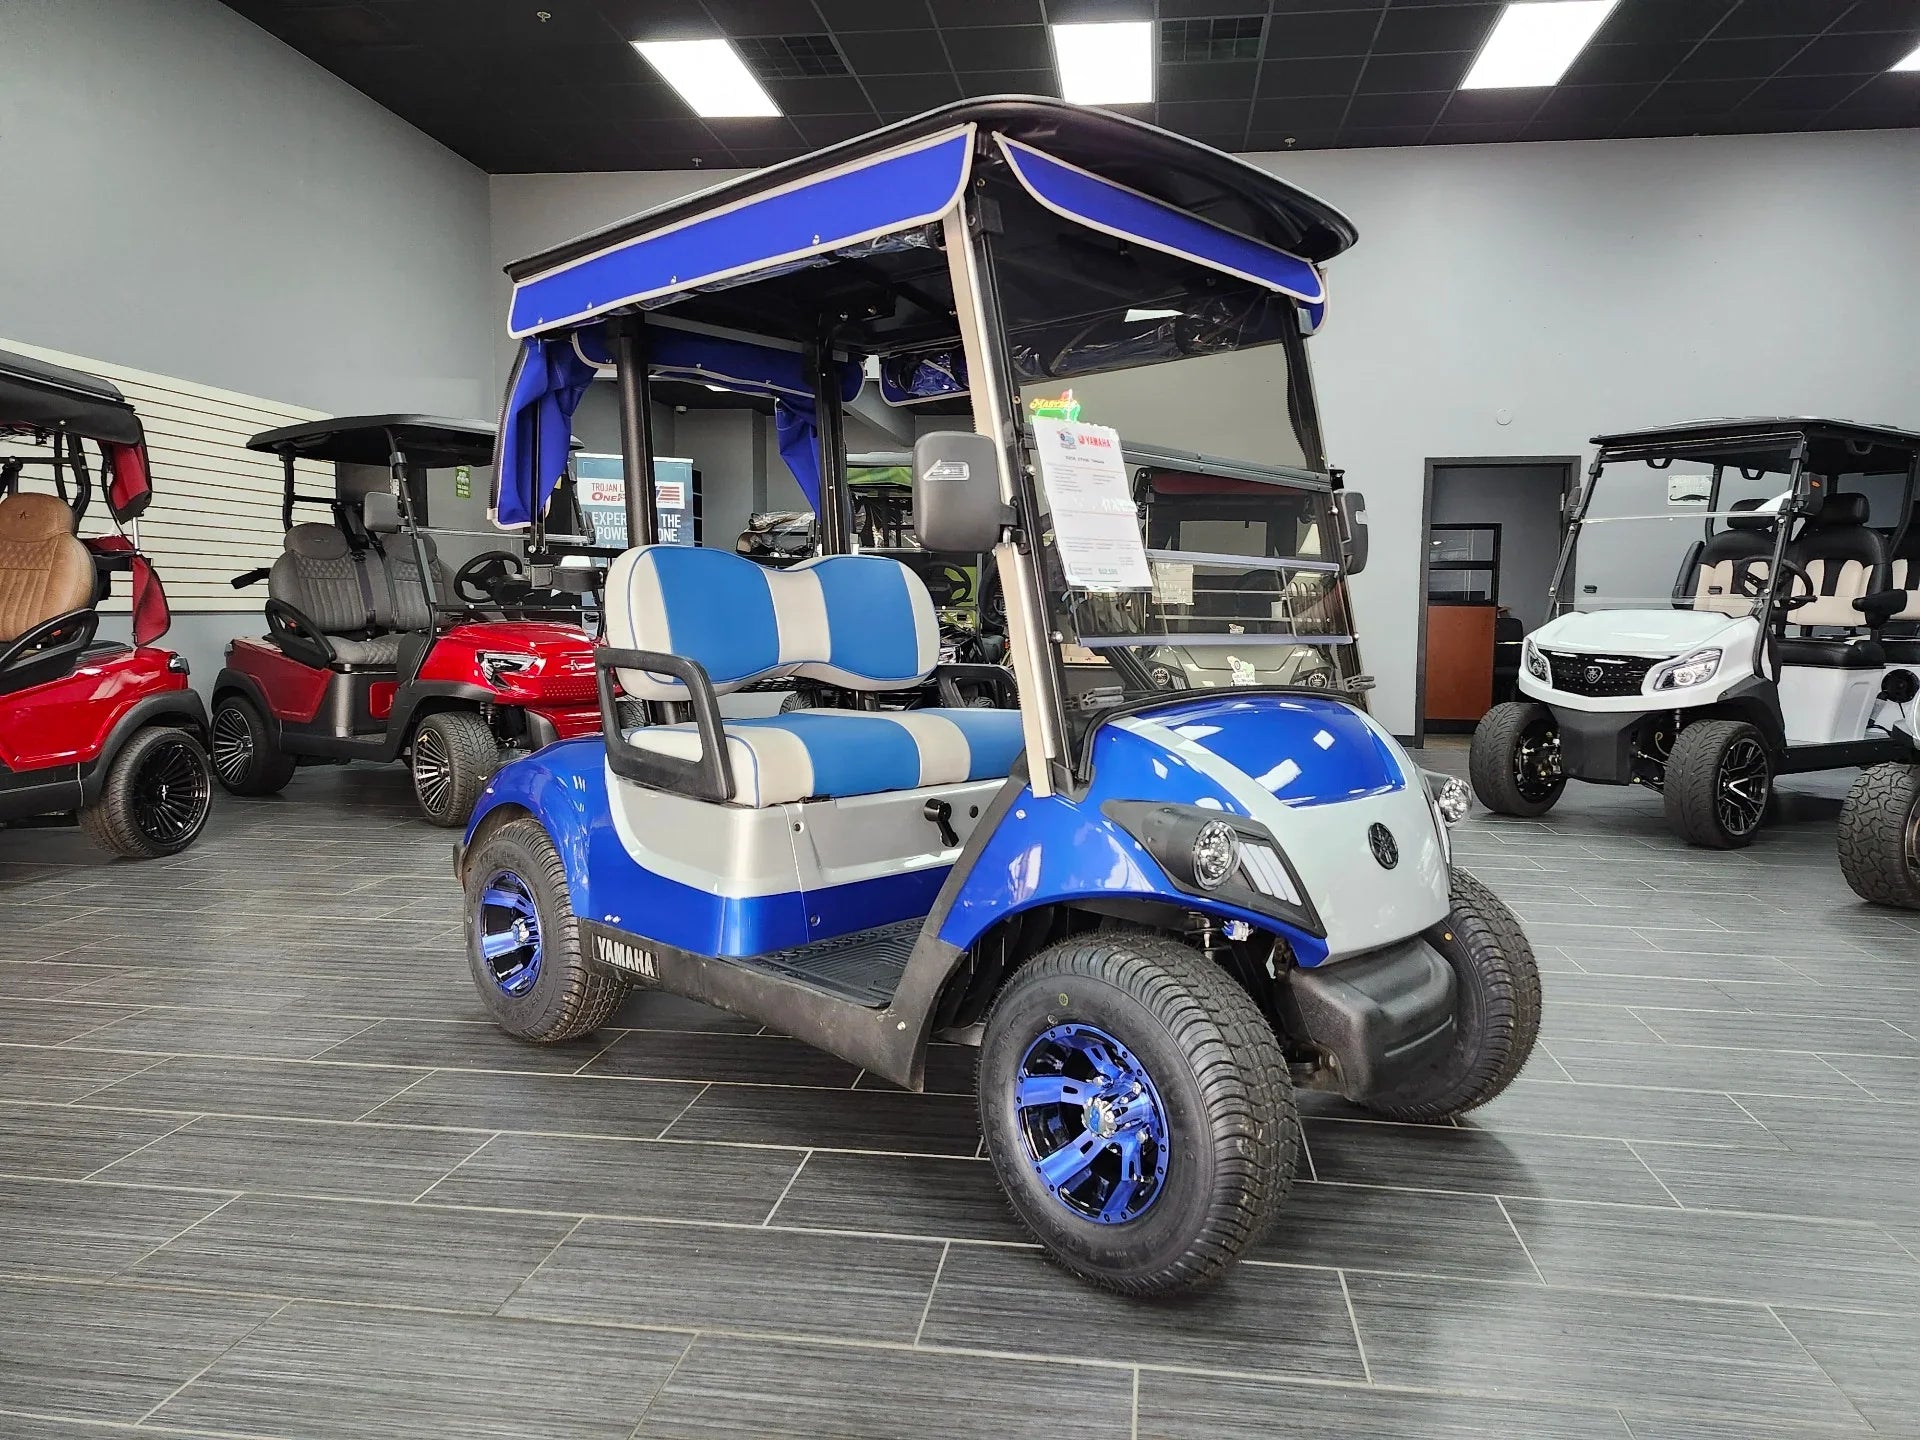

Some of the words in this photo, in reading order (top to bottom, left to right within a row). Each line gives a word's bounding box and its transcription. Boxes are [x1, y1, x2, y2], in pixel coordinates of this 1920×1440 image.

[591, 482, 618, 492] TROJAN
[592, 512, 627, 526] EXPER
[661, 514, 681, 527] THE
[596, 526, 628, 541] POWE
[597, 935, 655, 977] YAMAHA
